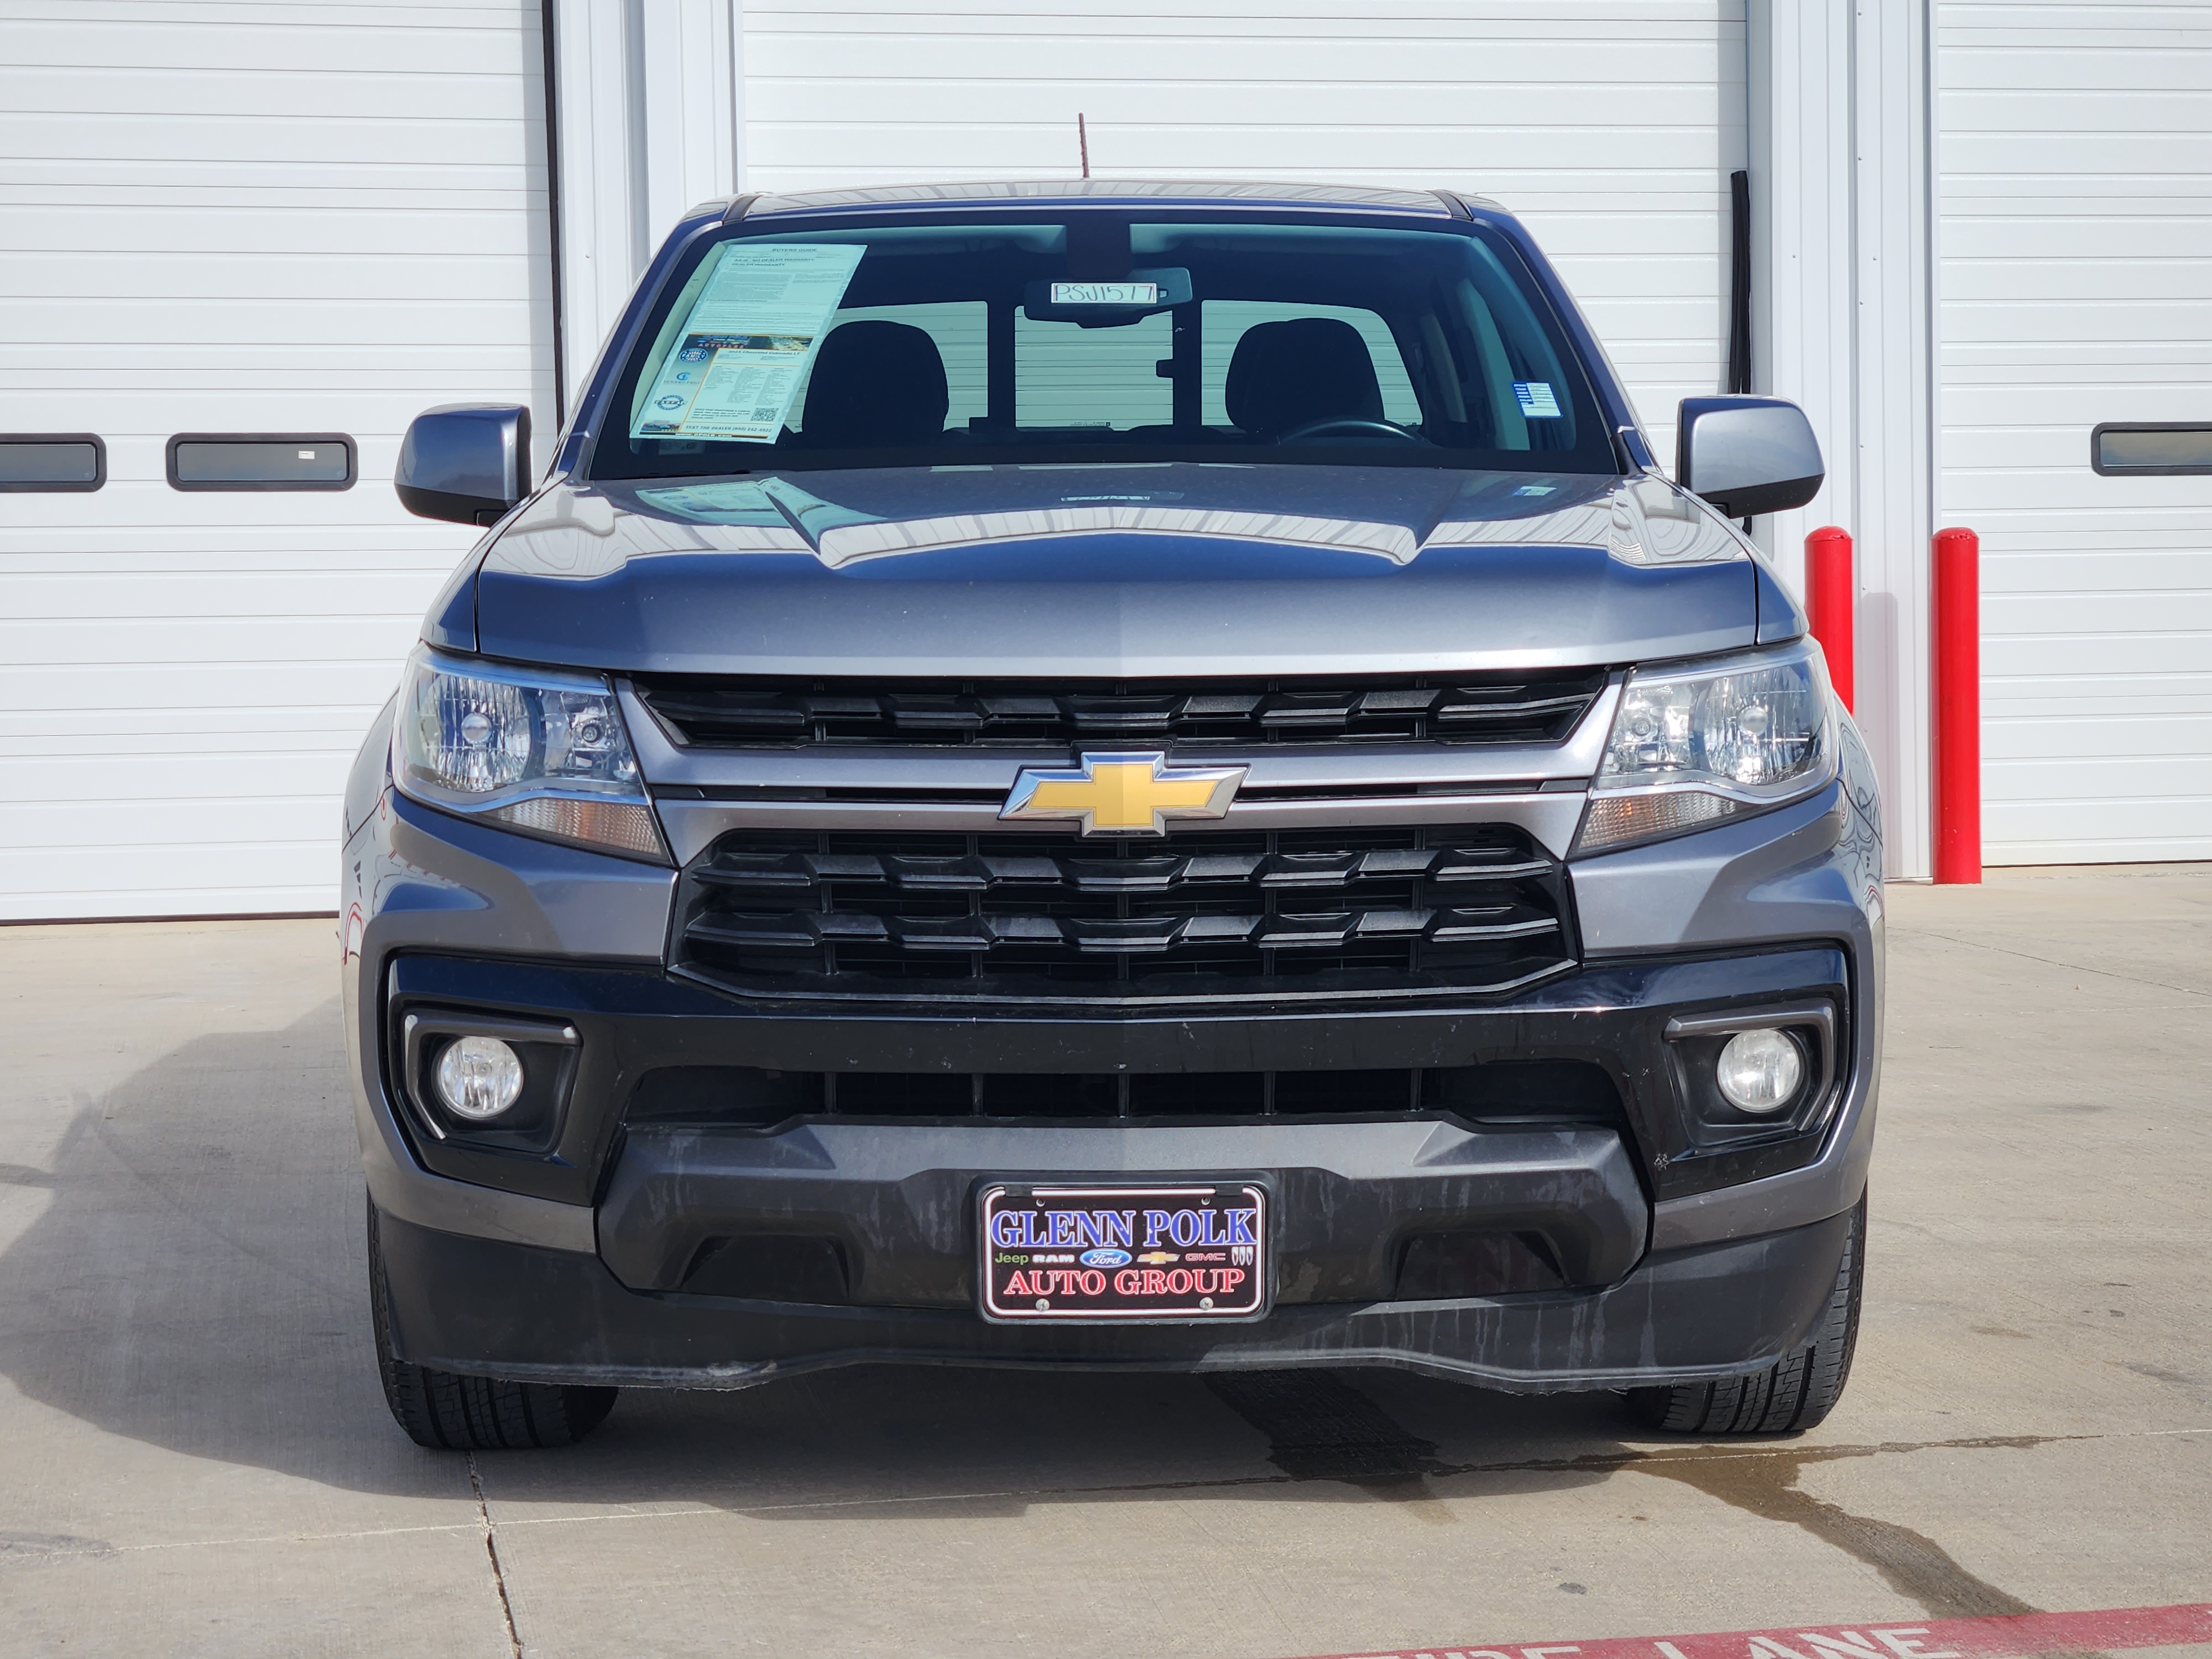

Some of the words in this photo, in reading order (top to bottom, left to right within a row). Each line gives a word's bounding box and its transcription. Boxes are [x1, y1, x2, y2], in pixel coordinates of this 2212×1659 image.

[991, 1209, 1136, 1248] GLENN
[1142, 1208, 1257, 1247] POLK
[995, 1252, 1029, 1265] Jeep
[1032, 1254, 1074, 1264] RAM
[1089, 1251, 1123, 1265] Ford
[1185, 1253, 1227, 1261] GMC
[1004, 1270, 1107, 1295] AUTO
[1114, 1269, 1245, 1295] GROUP
